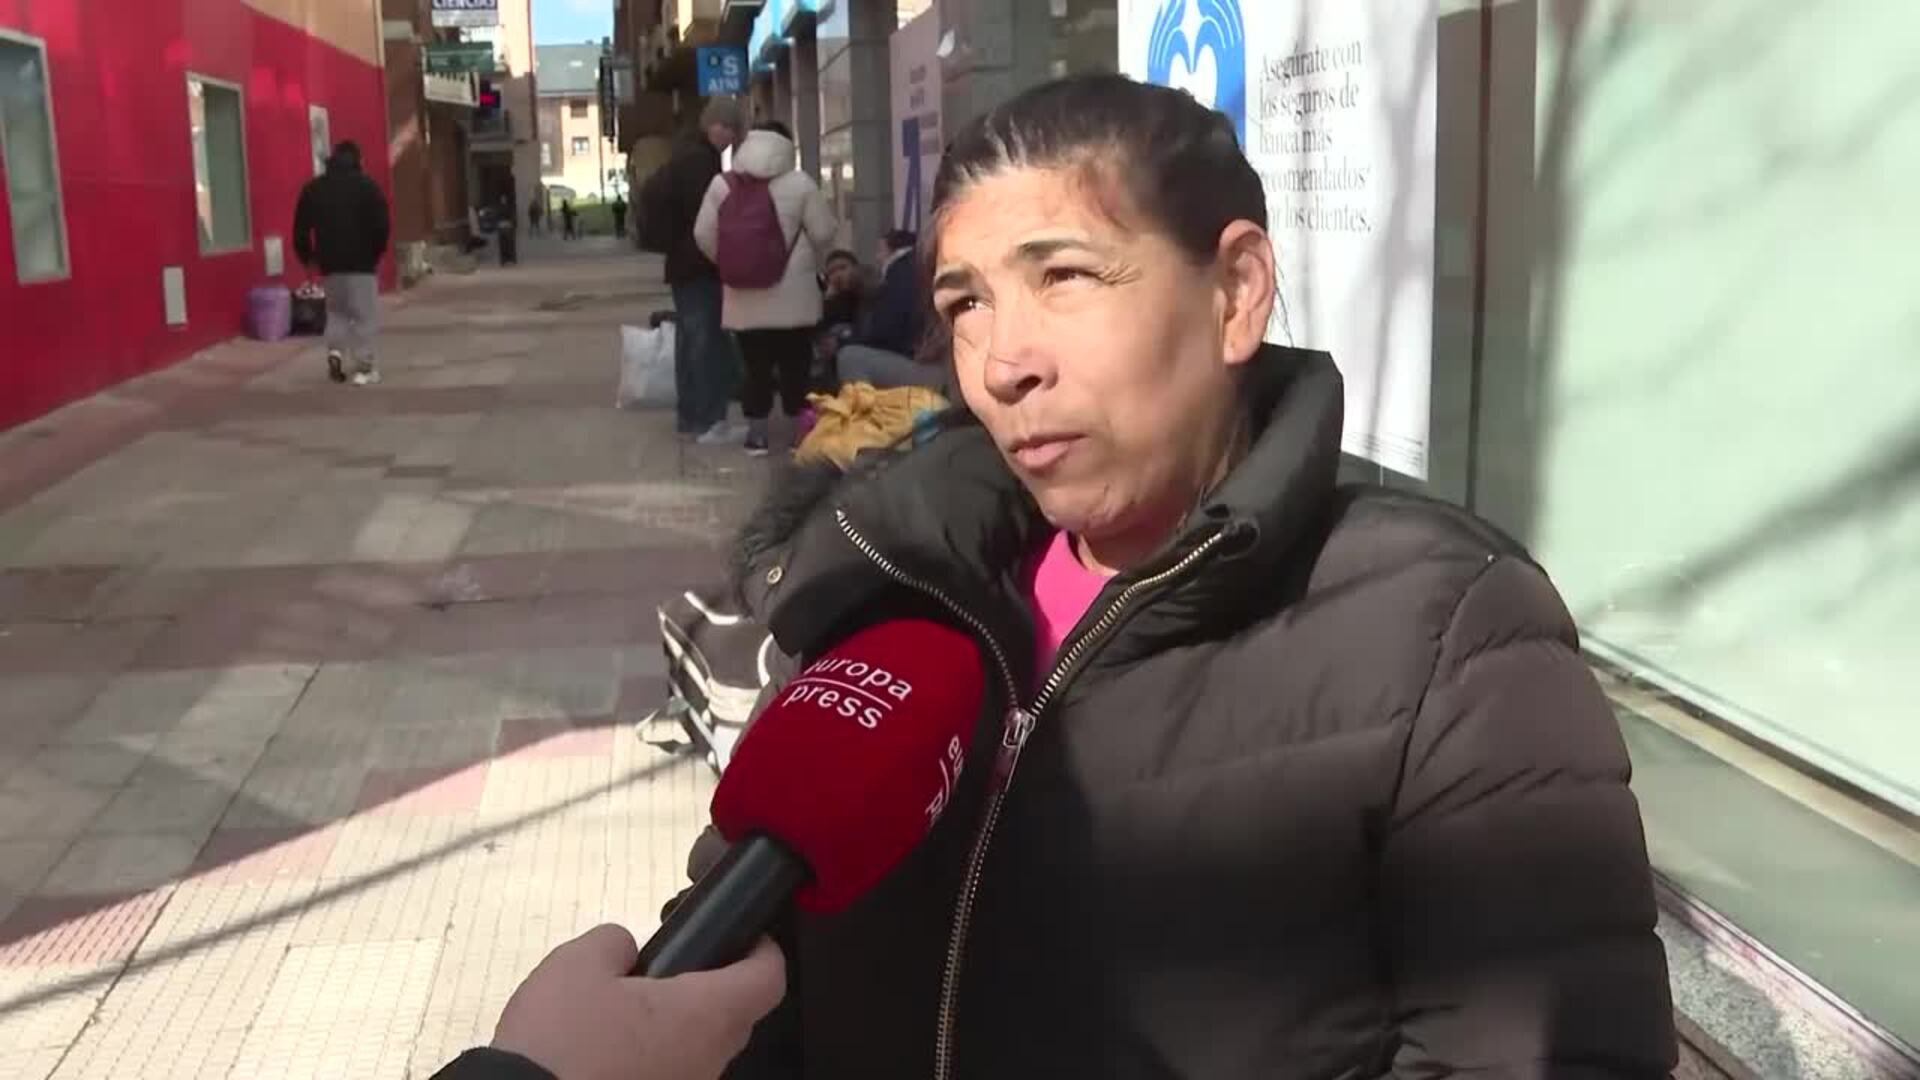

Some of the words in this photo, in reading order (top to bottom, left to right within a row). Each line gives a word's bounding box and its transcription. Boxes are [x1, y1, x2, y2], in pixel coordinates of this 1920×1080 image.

[1259, 41, 1327, 88] Asegúrate
[1332, 40, 1361, 69] con
[1259, 83, 1277, 119] los
[1280, 87, 1335, 125] seguros
[1340, 71, 1360, 109] de
[1259, 122, 1299, 155] banca
[1301, 116, 1332, 153] más
[781, 684, 883, 729] press
